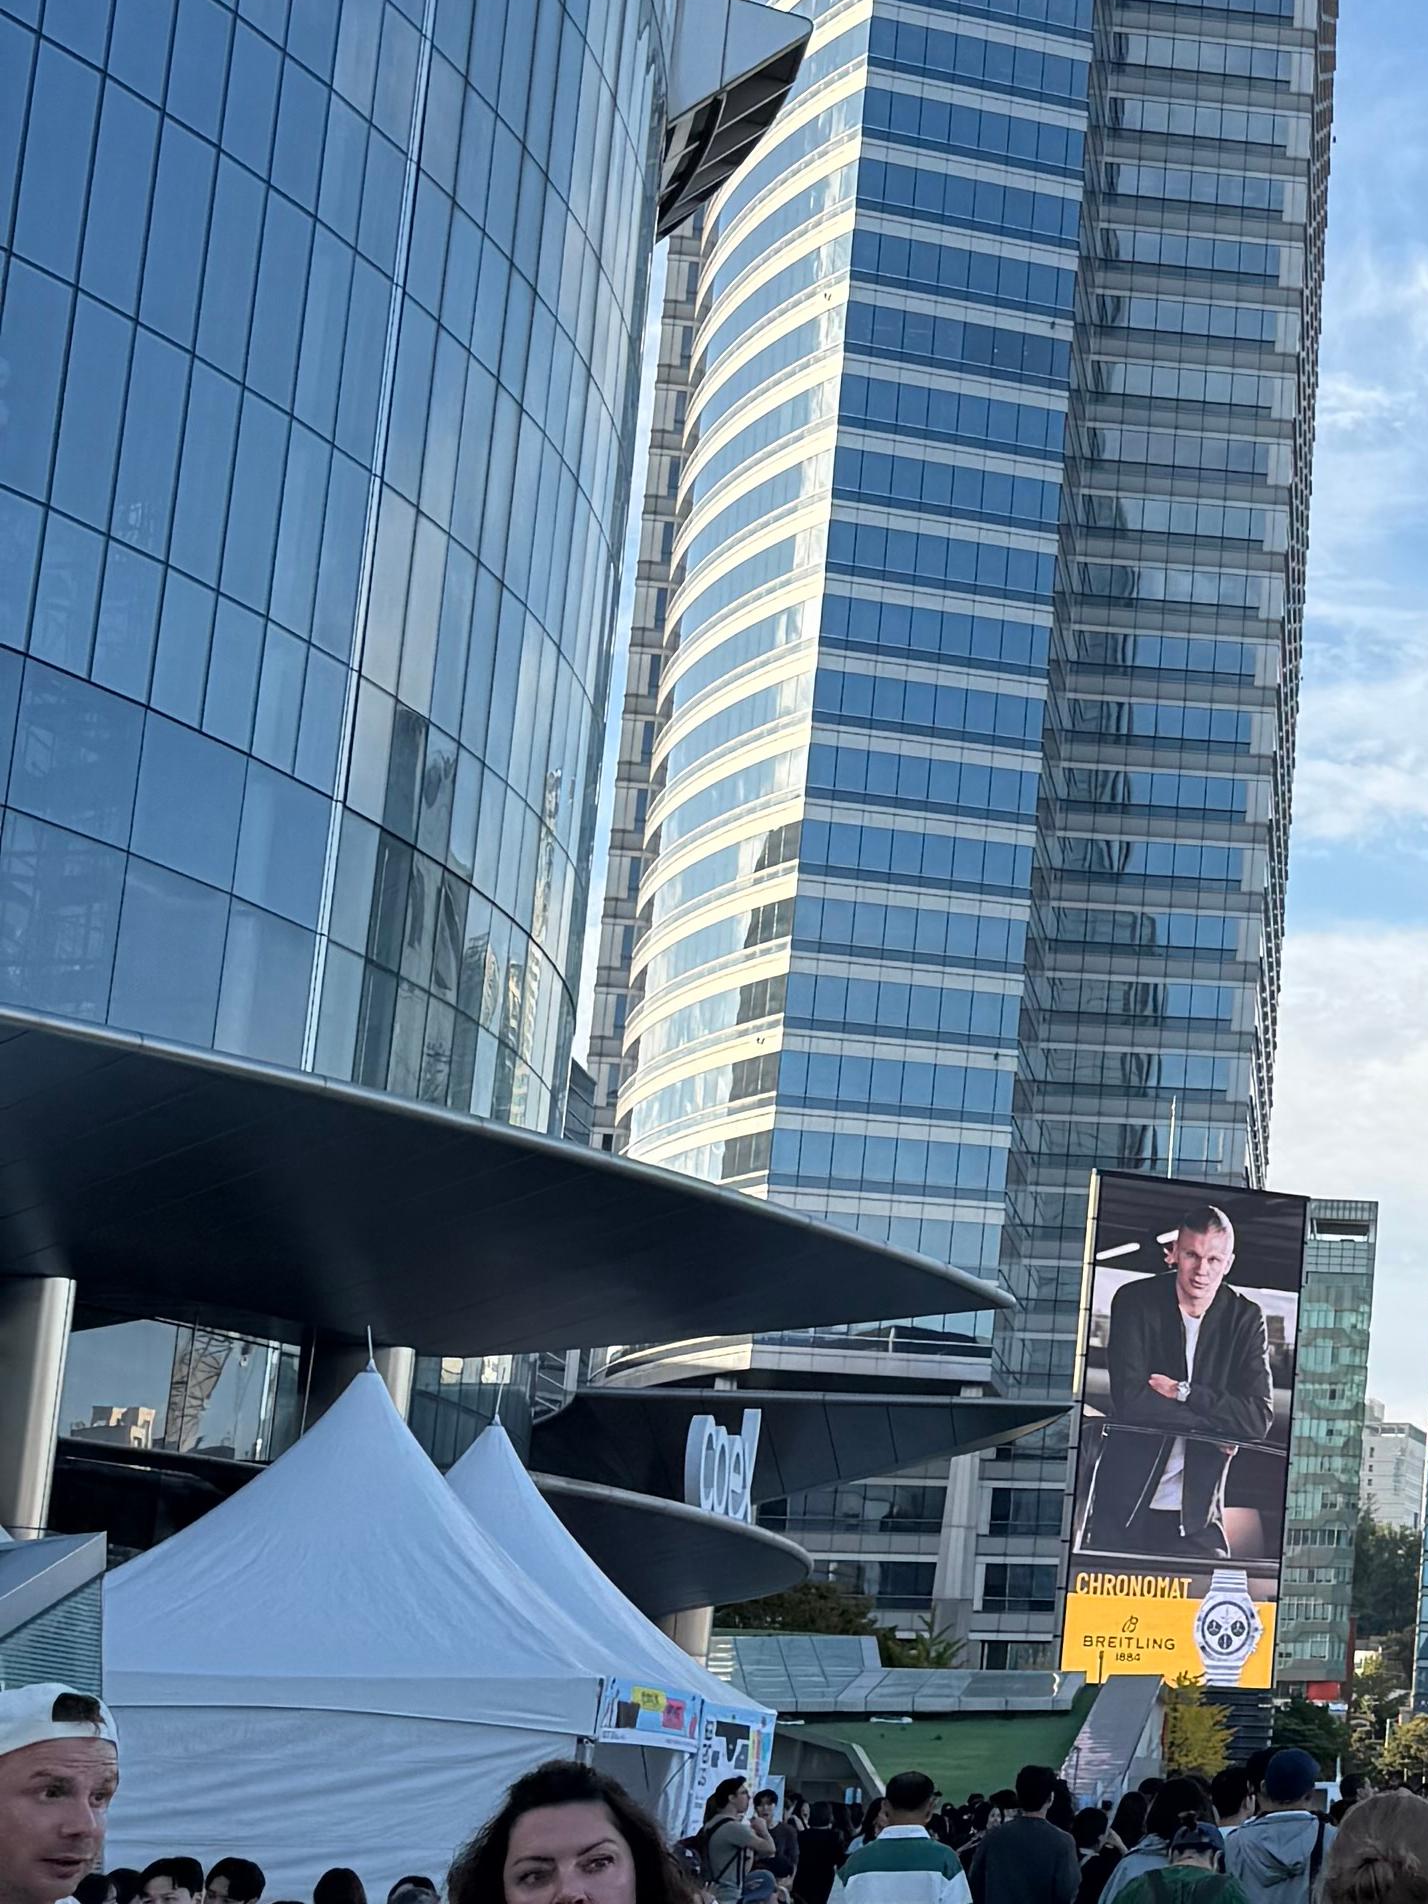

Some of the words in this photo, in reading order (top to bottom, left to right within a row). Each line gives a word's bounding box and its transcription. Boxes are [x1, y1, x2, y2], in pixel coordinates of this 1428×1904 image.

[1076, 1572, 1192, 1599] CHRONOMAT
[1083, 1636, 1175, 1650] BREITLING
[1115, 1653, 1141, 1662] 1884
